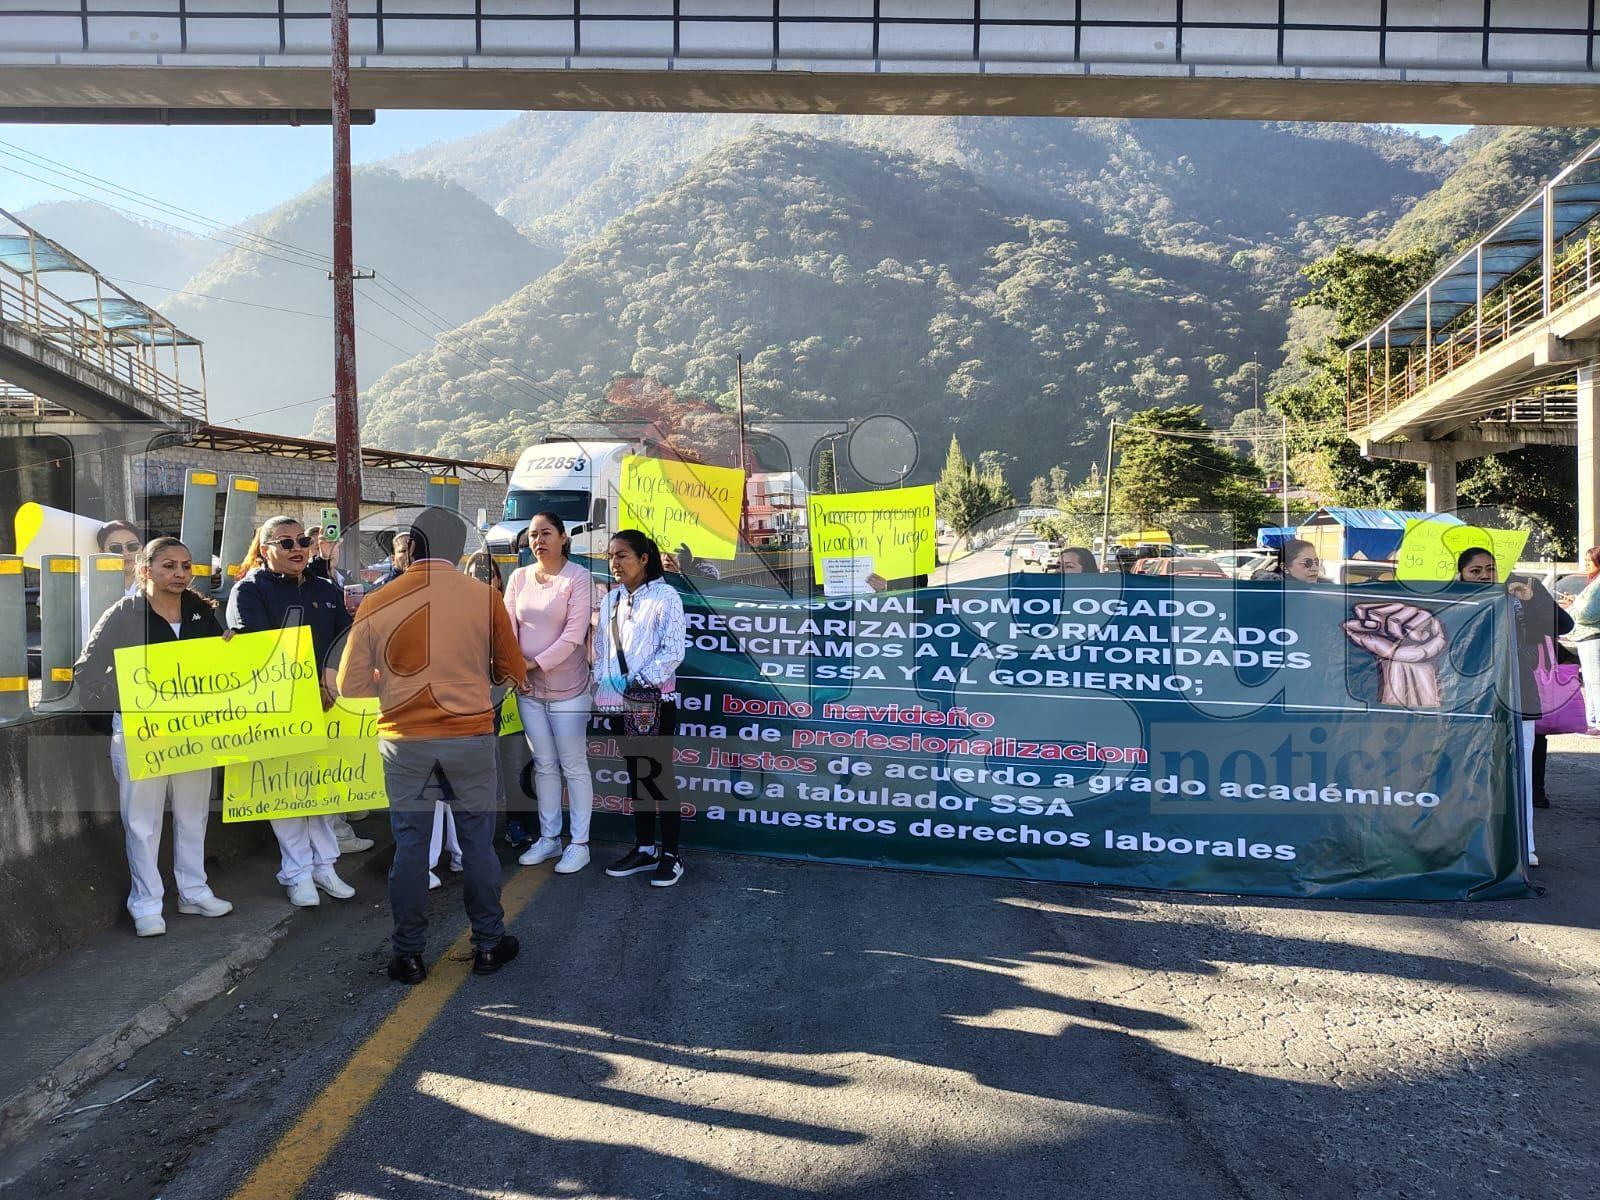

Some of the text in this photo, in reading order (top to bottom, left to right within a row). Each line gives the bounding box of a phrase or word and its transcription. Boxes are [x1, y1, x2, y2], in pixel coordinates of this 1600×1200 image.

[527, 456, 586, 472] T22853
[664, 507, 700, 531] para
[813, 503, 867, 527] Primero
[818, 530, 868, 552] lización
[894, 526, 929, 553] luego
[936, 597, 1227, 621] HOMOLOGADO,
[685, 613, 1299, 645] REGULARIZADO Y FORMALIZADO
[683, 634, 1312, 669] SOLICITAMOS A LAS AUTORIDADES
[133, 652, 314, 710] Salarios justos
[759, 663, 1203, 695] DE SSA Y AL GOBIERNO;
[138, 691, 276, 743] de acuerdo al
[722, 694, 813, 718] bono
[822, 702, 995, 728] navideño
[145, 720, 313, 773] grado académico
[327, 720, 341, 740] a
[738, 723, 781, 742] de
[791, 729, 1148, 764] profesionalizacion
[250, 753, 368, 800] Antigüedad
[708, 747, 817, 774] justos
[827, 756, 872, 776] de
[884, 763, 1041, 788] acuerdo
[1053, 771, 1075, 788] a
[1088, 774, 1206, 795] grado
[1219, 782, 1440, 808] académico
[256, 801, 271, 814] de
[322, 795, 341, 807] sin
[347, 788, 385, 803] bases
[763, 782, 785, 798] a
[797, 782, 979, 811] tabulador
[990, 794, 1074, 817] SSA
[706, 805, 725, 821] a
[738, 806, 896, 834] nuestros
[909, 818, 1091, 847] derechos
[1105, 830, 1296, 860] laborales
